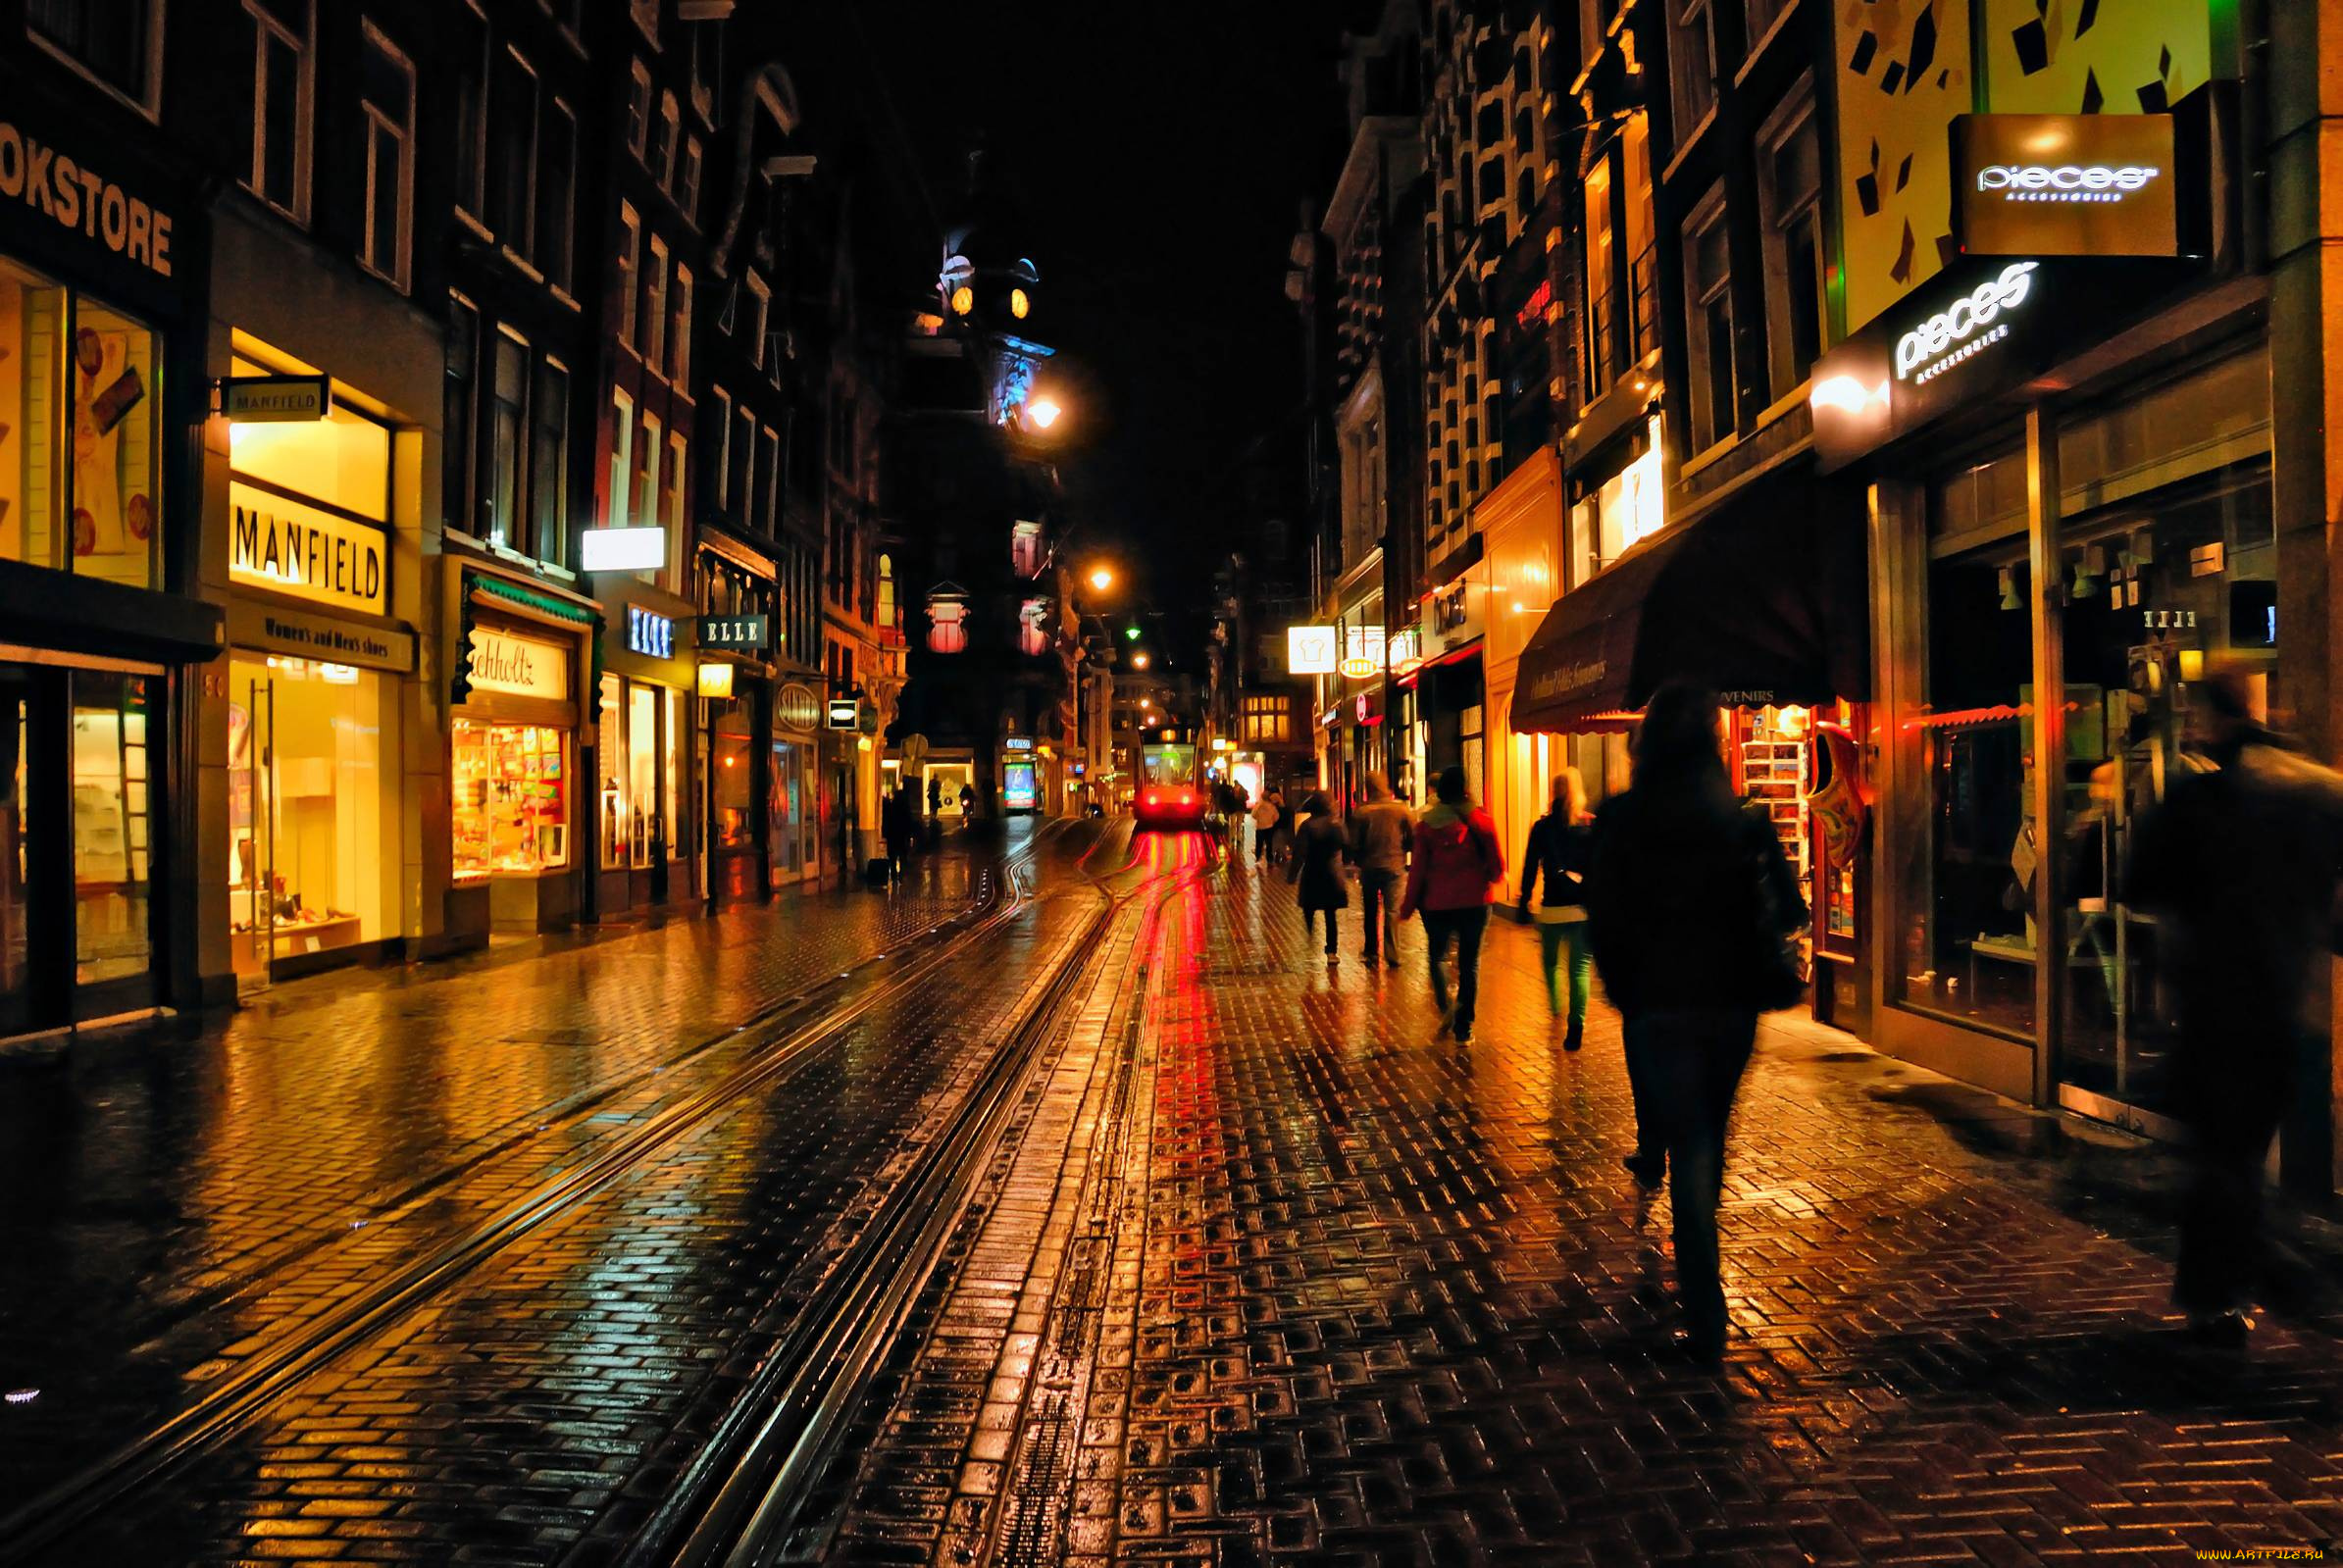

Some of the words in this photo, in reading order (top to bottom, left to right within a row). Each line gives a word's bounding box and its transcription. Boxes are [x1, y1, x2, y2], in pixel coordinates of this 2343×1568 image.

[1978, 166, 2151, 191] pieces
[1896, 262, 2039, 379] pieces
[236, 394, 316, 409] MANFIELD
[236, 506, 379, 599] MANFIELD
[314, 629, 332, 648] and
[363, 635, 388, 658] shoes
[707, 623, 758, 642] ELLE
